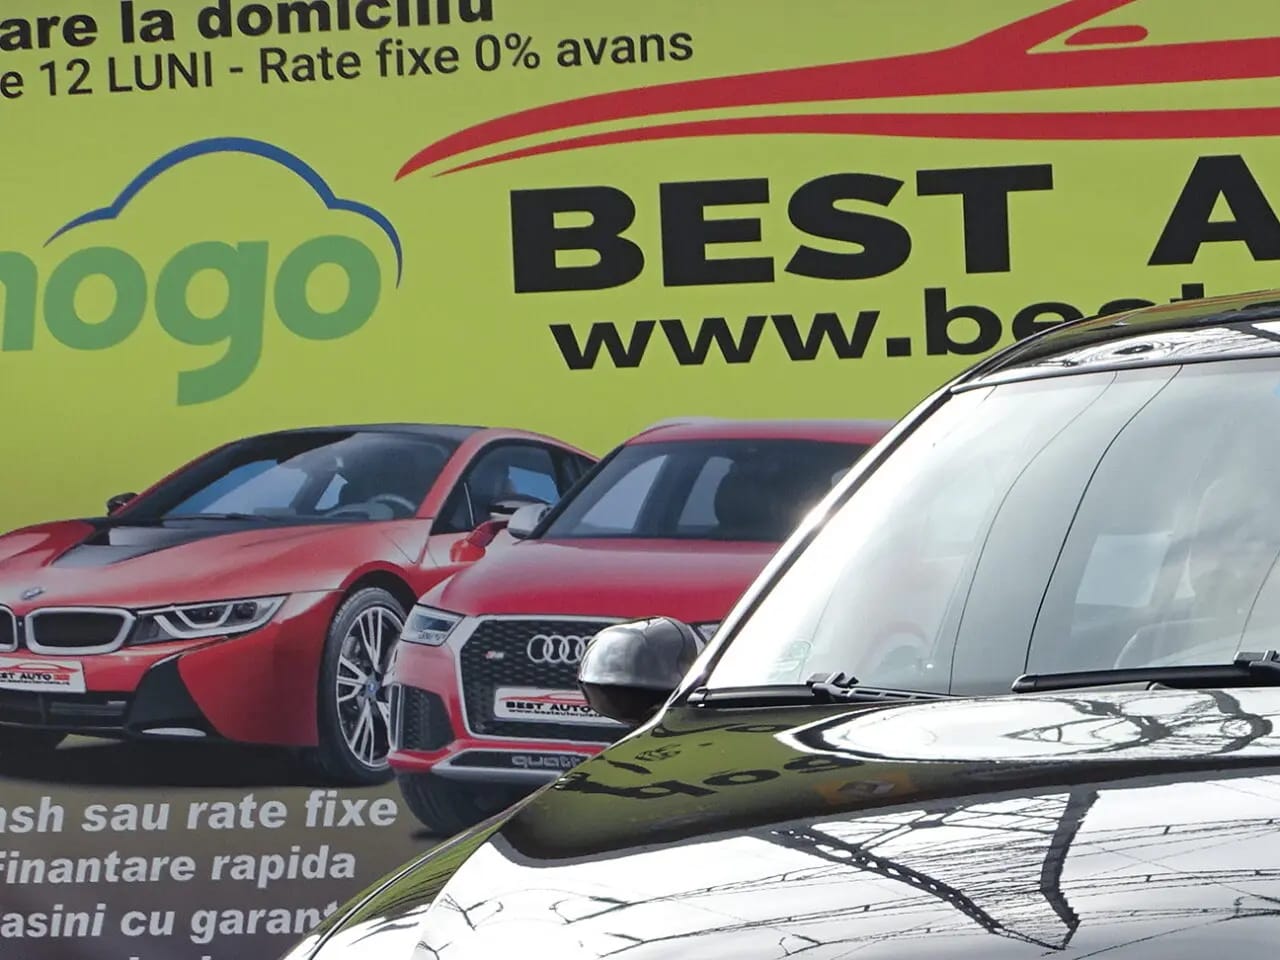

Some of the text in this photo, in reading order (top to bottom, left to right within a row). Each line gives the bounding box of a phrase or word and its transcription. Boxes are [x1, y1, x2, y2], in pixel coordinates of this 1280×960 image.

[0, 14, 98, 51] are
[120, 0, 175, 43] la
[0, 71, 24, 99] e
[39, 58, 93, 97] 12
[107, 51, 213, 93] LUNI
[259, 46, 362, 84] Rate
[375, 37, 460, 78] fixe
[475, 32, 541, 72] 0%
[556, 30, 694, 68] avans
[509, 163, 1054, 294] BEST
[0, 234, 382, 407] ogo
[506, 701, 591, 713] BEST AUTO
[82, 803, 170, 832] sau
[187, 794, 287, 830] rate
[304, 790, 398, 827] fixe
[211, 844, 356, 889] rapida
[120, 910, 175, 937] cu
